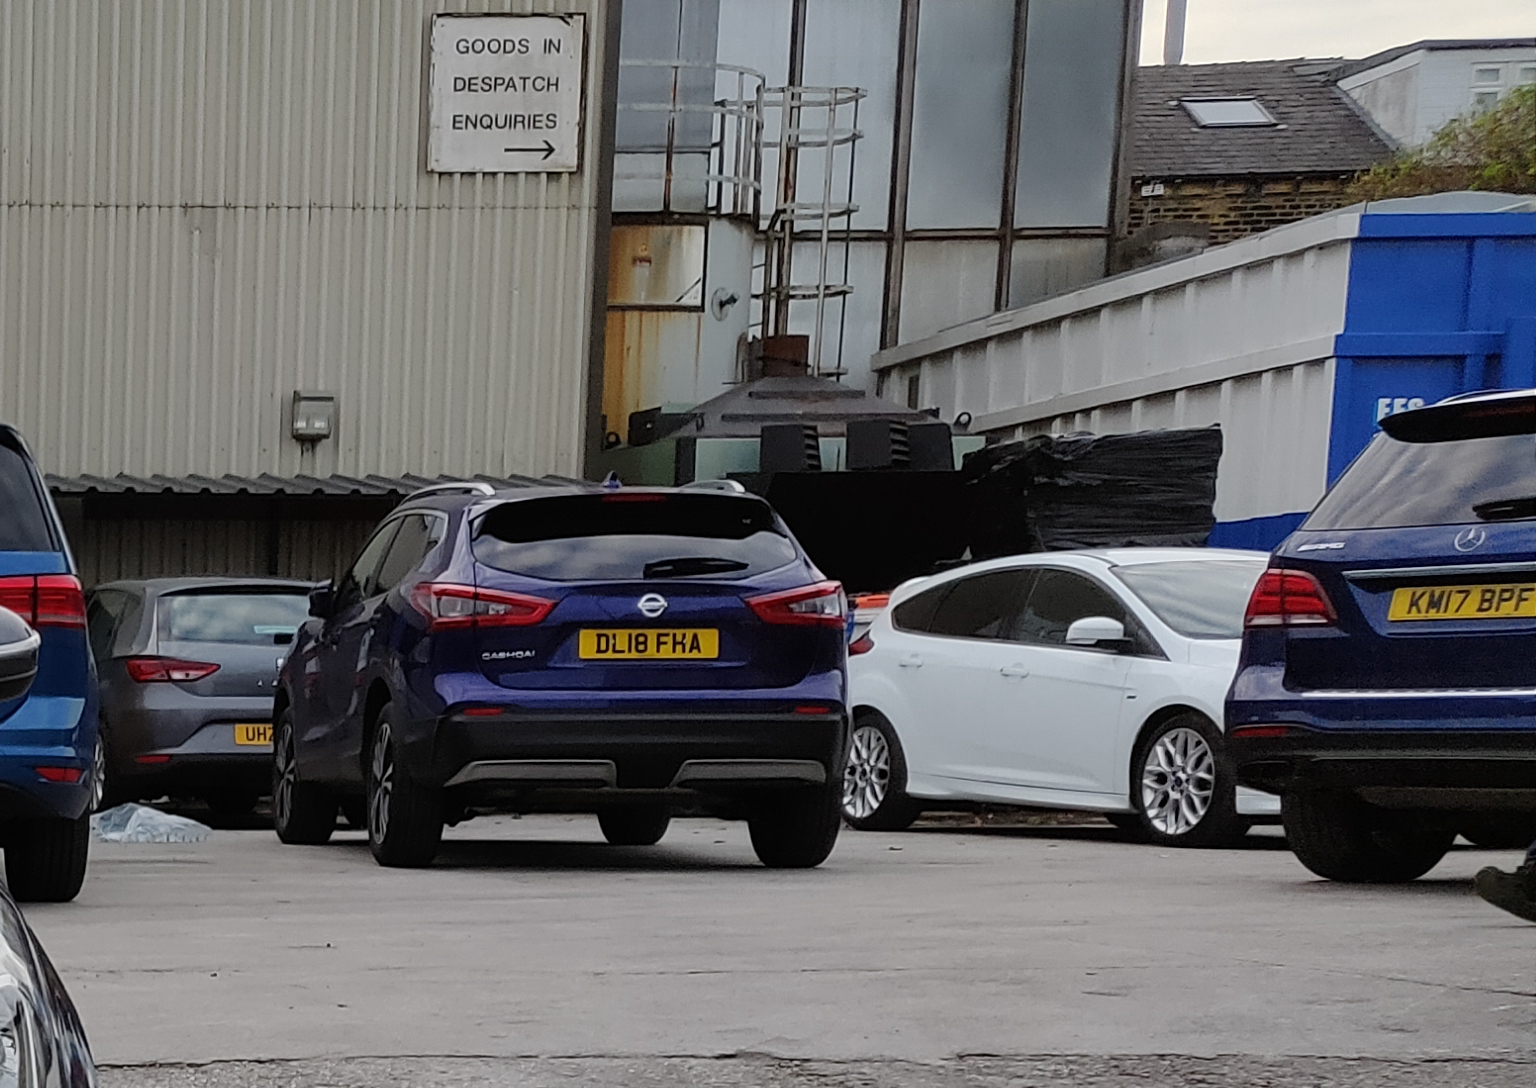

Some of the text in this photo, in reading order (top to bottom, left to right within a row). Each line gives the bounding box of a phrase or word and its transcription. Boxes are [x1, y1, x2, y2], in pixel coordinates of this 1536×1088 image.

[455, 38, 562, 55] GOODS IN
[453, 76, 560, 93] DESPATCH
[452, 113, 558, 131] ENQUIRIES
[1406, 587, 1536, 615] KM17 BPF
[595, 632, 649, 654] DL18
